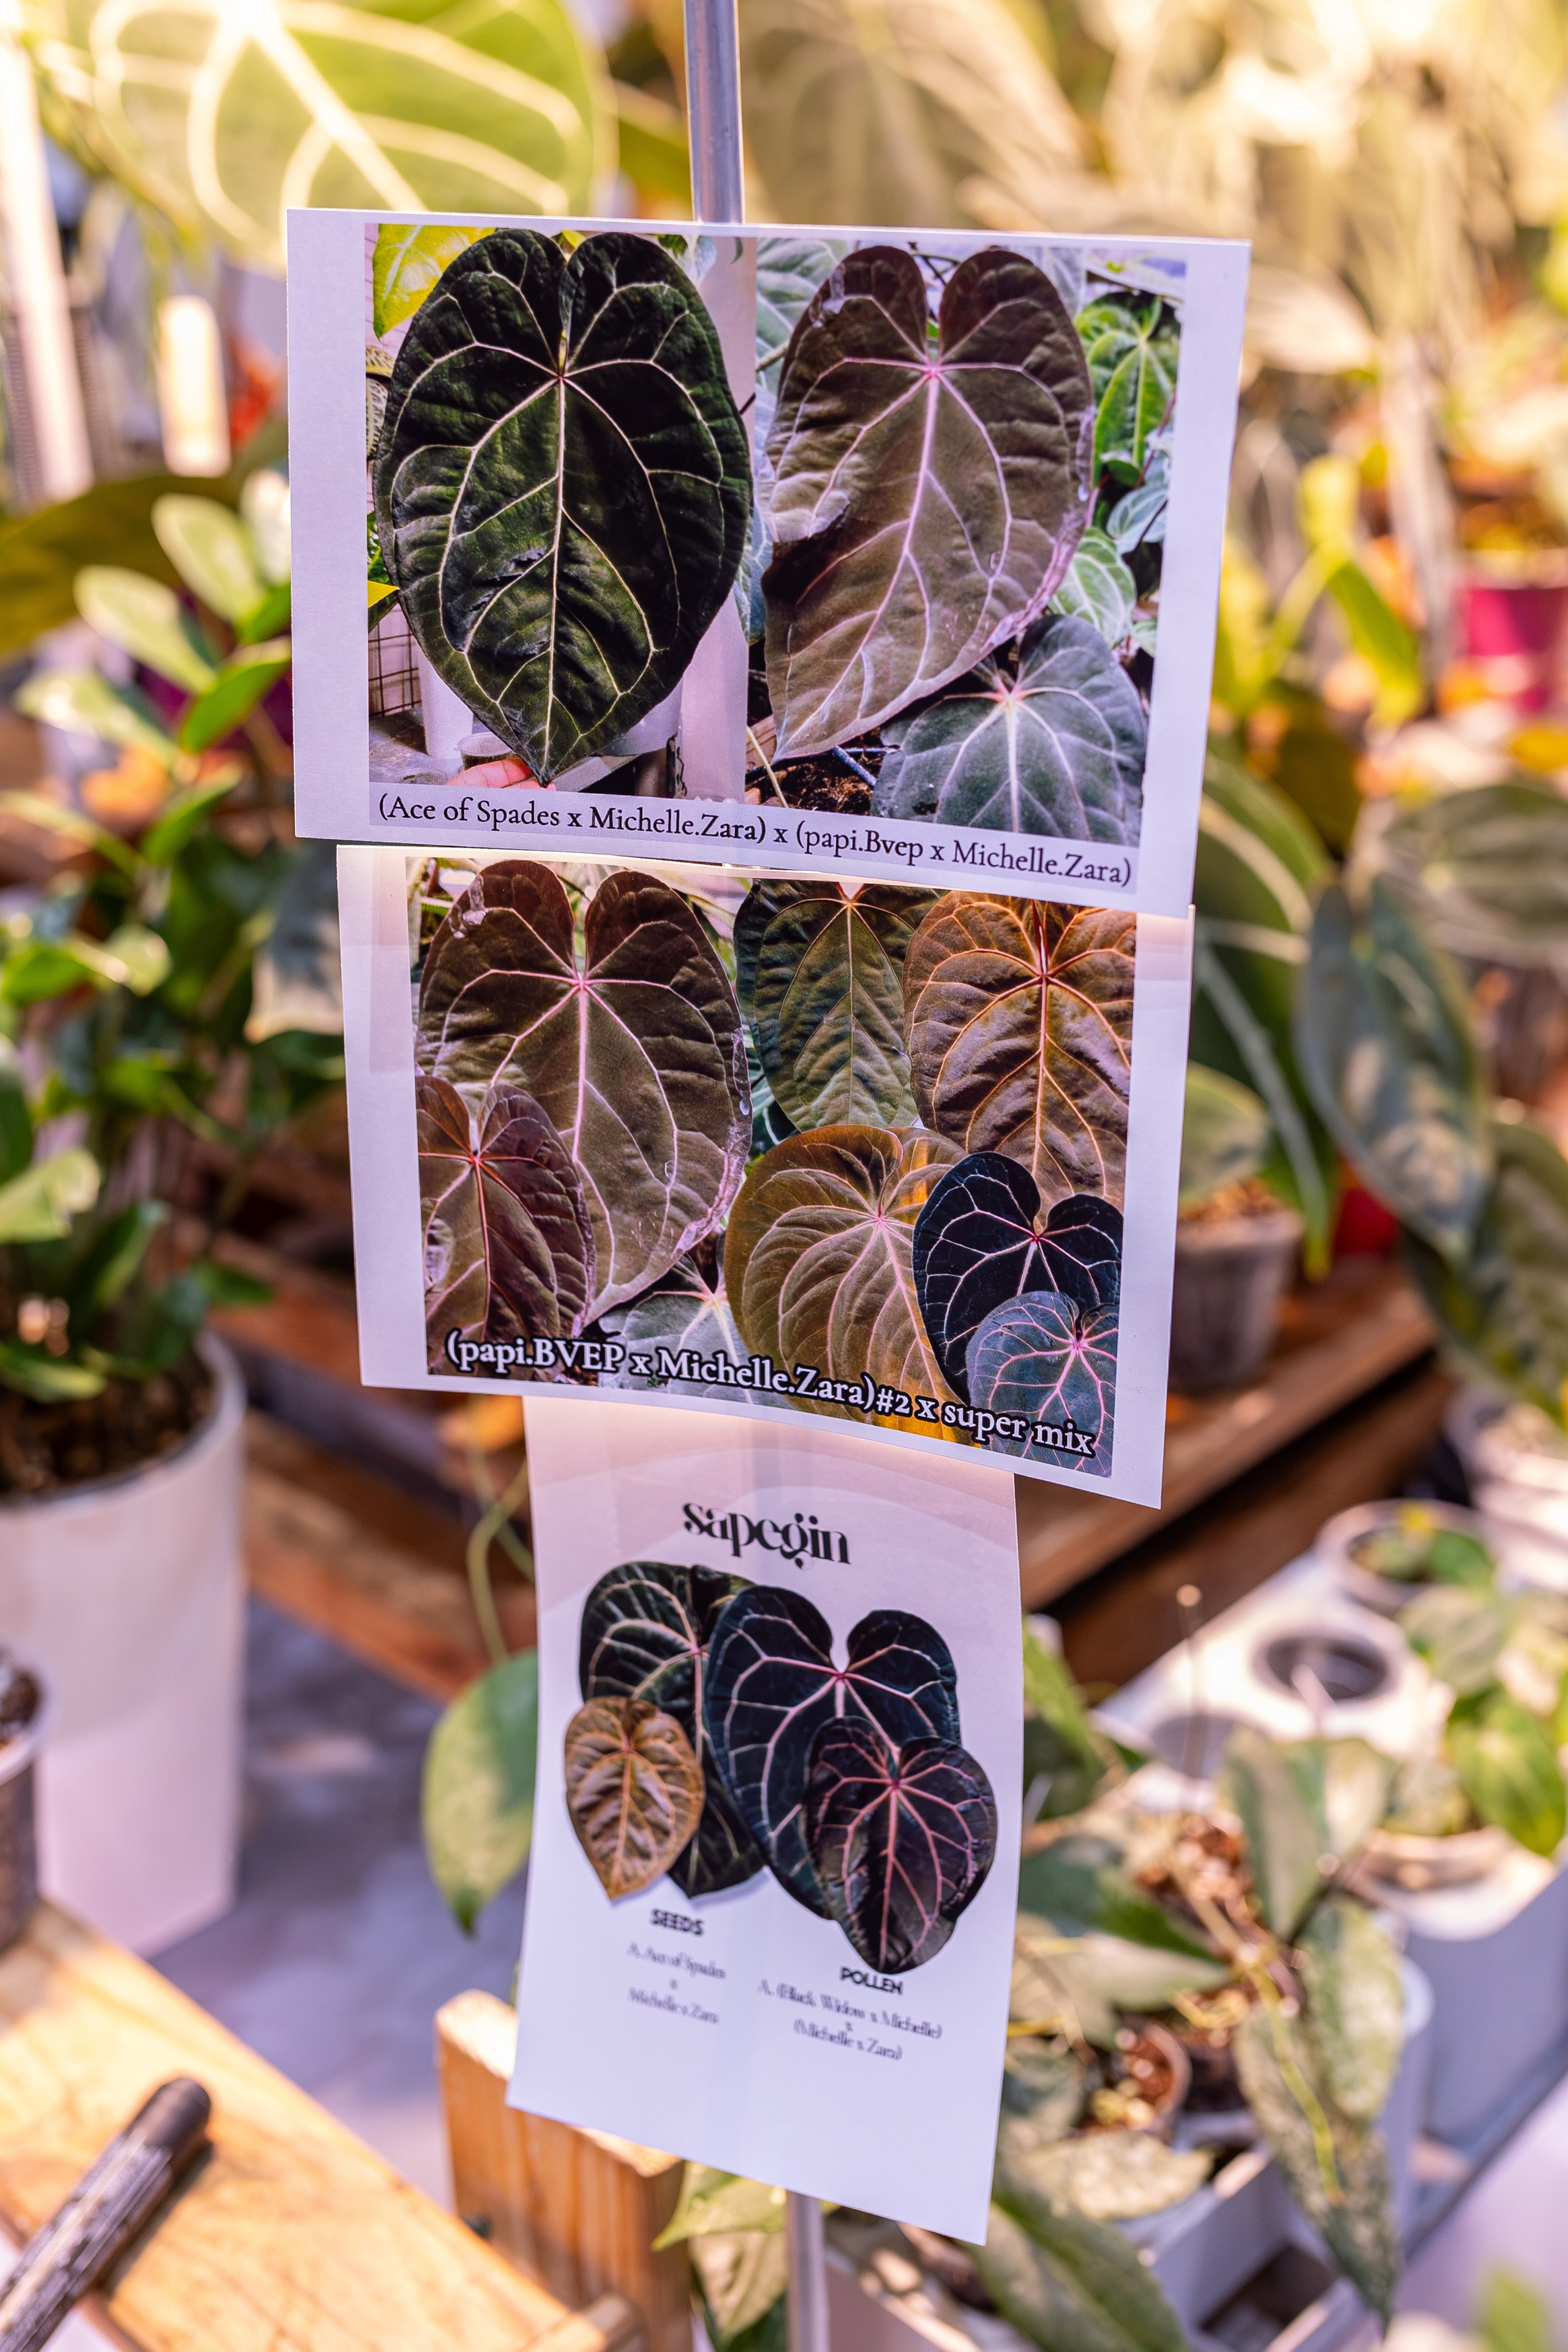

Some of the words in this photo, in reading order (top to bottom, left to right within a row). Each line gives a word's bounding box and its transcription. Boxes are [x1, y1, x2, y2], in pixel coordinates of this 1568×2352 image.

[379, 793, 436, 821] (Ace
[443, 796, 473, 821] of
[477, 801, 560, 831] Spades
[568, 813, 582, 827] x
[590, 807, 767, 844] Michelle.Zara)
[773, 829, 788, 844] x
[797, 821, 924, 865] (papi.Bvep
[930, 846, 945, 861] x
[952, 840, 1132, 888] Michelle.Zara)
[447, 1330, 625, 1373] (papi.BVEP
[631, 1357, 652, 1374] x
[918, 1398, 937, 1421] x
[944, 1404, 1024, 1441] super
[1035, 1422, 1093, 1455] mix
[650, 1909, 703, 1936] SEEDS
[840, 1966, 903, 1995] POLLEN
